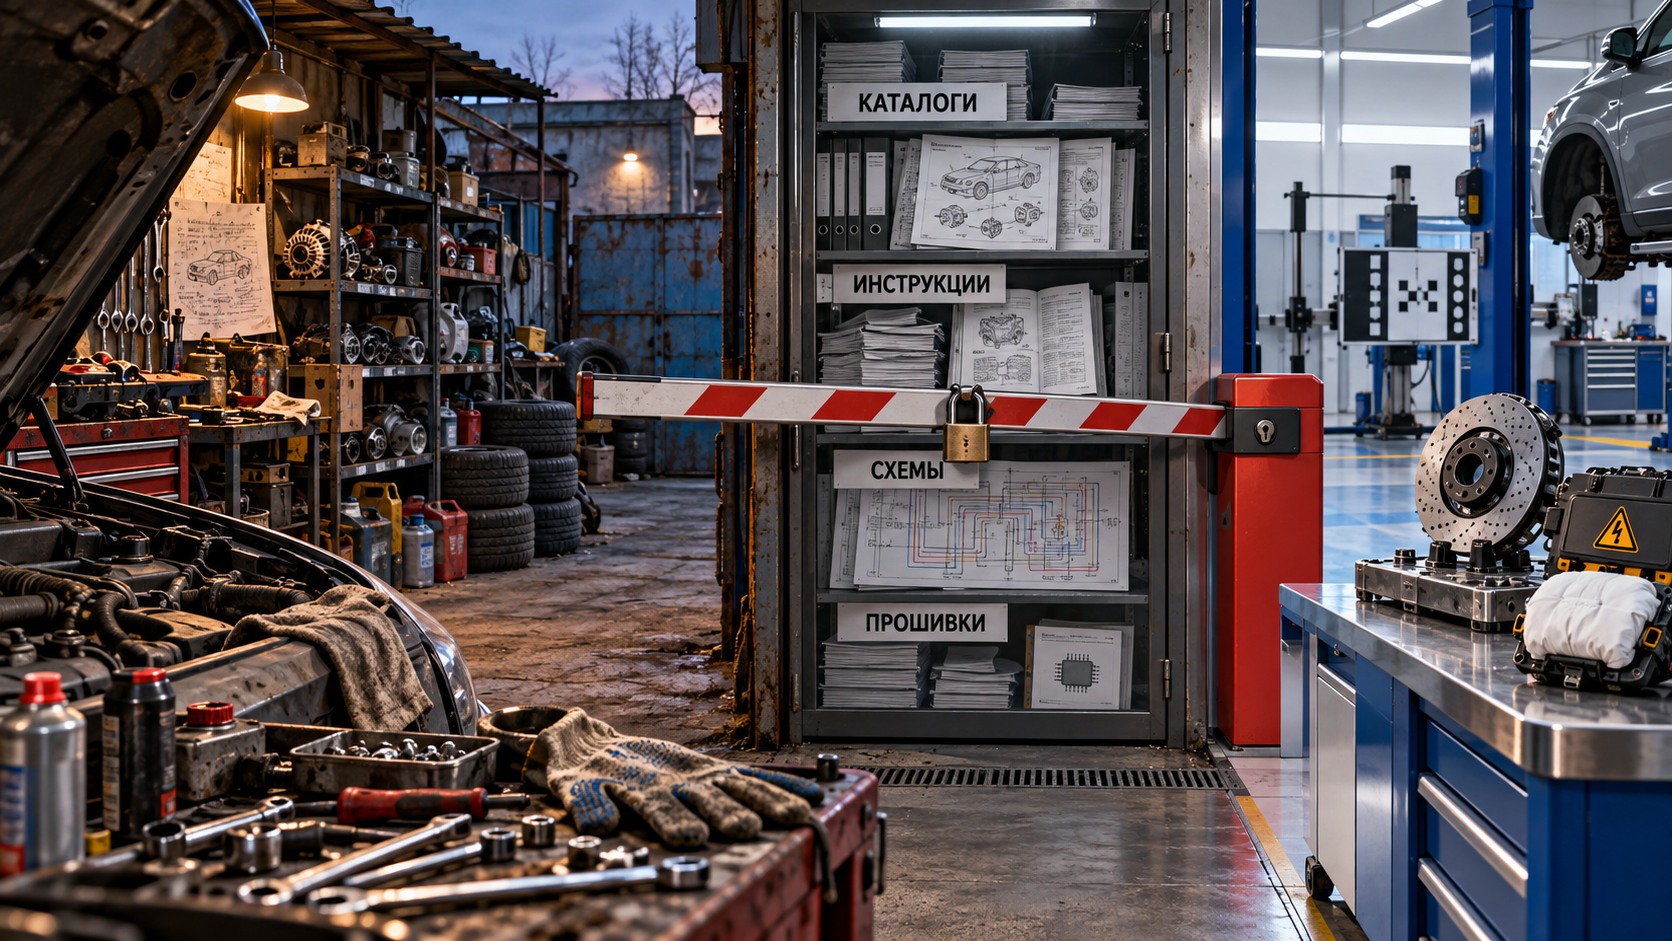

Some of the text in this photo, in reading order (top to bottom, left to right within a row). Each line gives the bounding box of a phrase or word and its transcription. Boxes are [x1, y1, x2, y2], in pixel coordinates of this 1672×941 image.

[858, 92, 978, 113] КАТАЛОГИ
[853, 274, 990, 297] ИНСТРУКЦИИ
[871, 460, 944, 480] СХЕМЫ
[865, 612, 986, 633] ПРОШИВКИ
